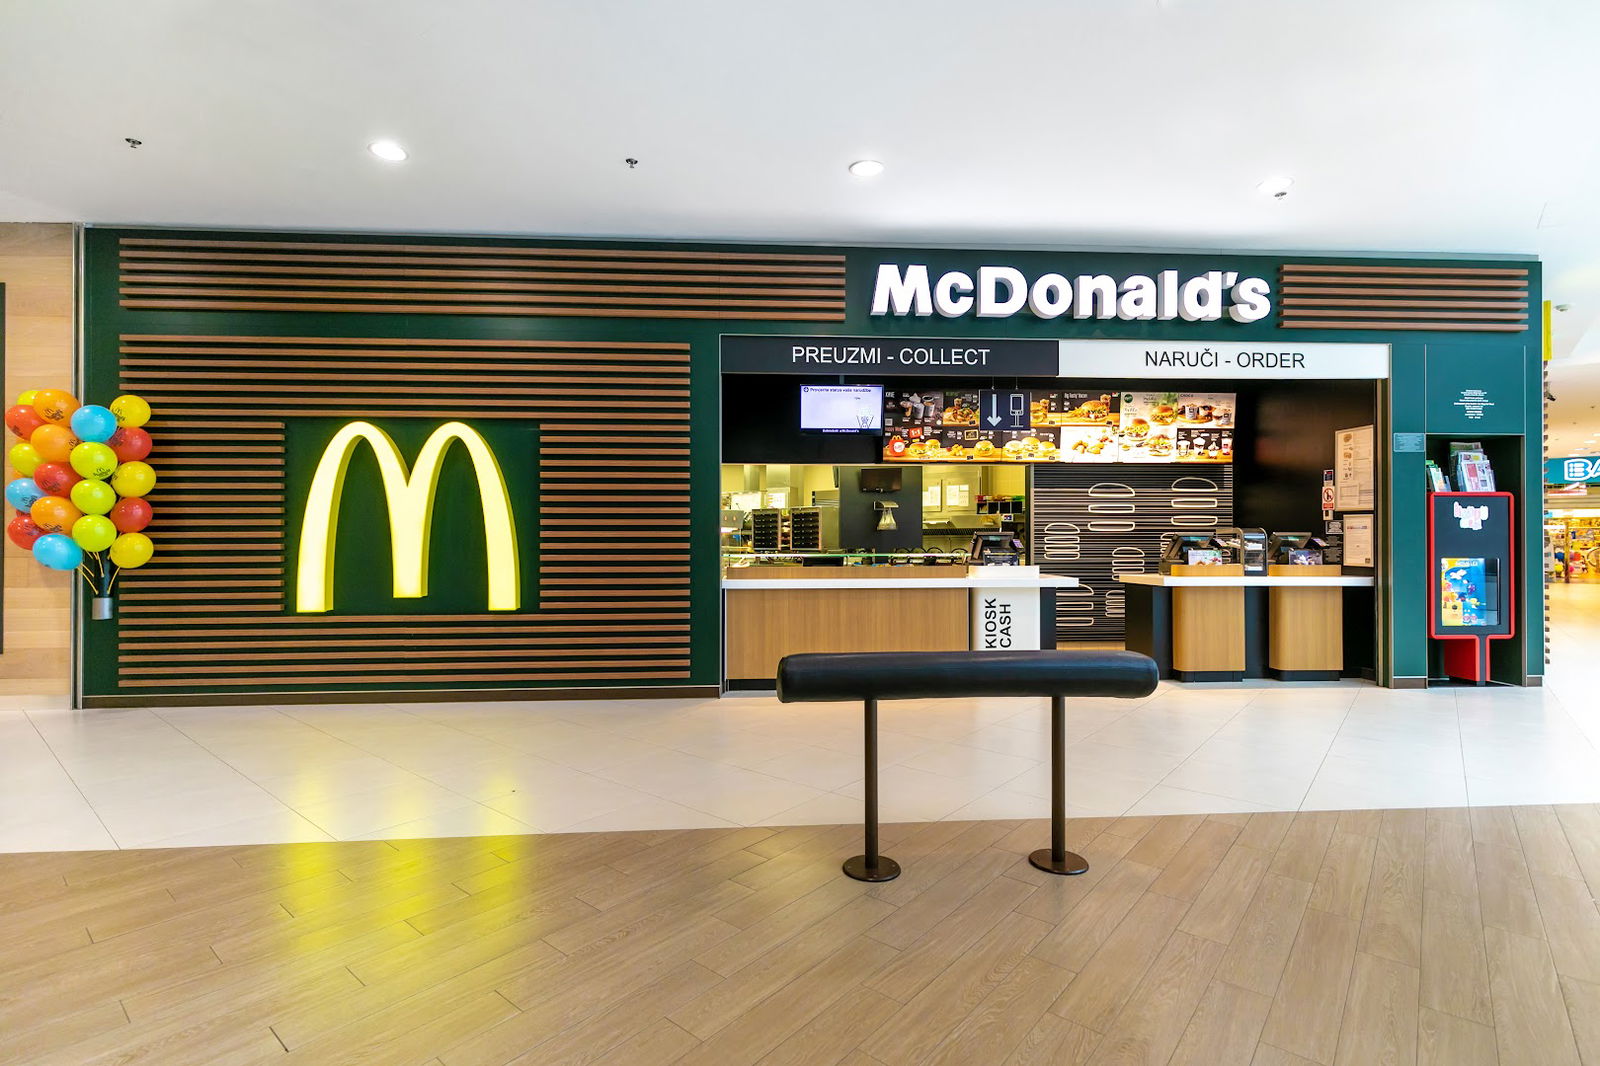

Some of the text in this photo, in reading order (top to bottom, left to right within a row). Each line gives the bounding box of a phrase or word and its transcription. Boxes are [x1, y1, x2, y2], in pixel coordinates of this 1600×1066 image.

[870, 264, 1271, 323] McDonald's
[792, 346, 881, 364] PREUZMI
[899, 347, 990, 365] COLLECT
[1145, 348, 1218, 367] NARUČI
[1236, 351, 1305, 368] ORDER
[985, 598, 997, 648] KIOSK
[999, 604, 1012, 648] CASH
